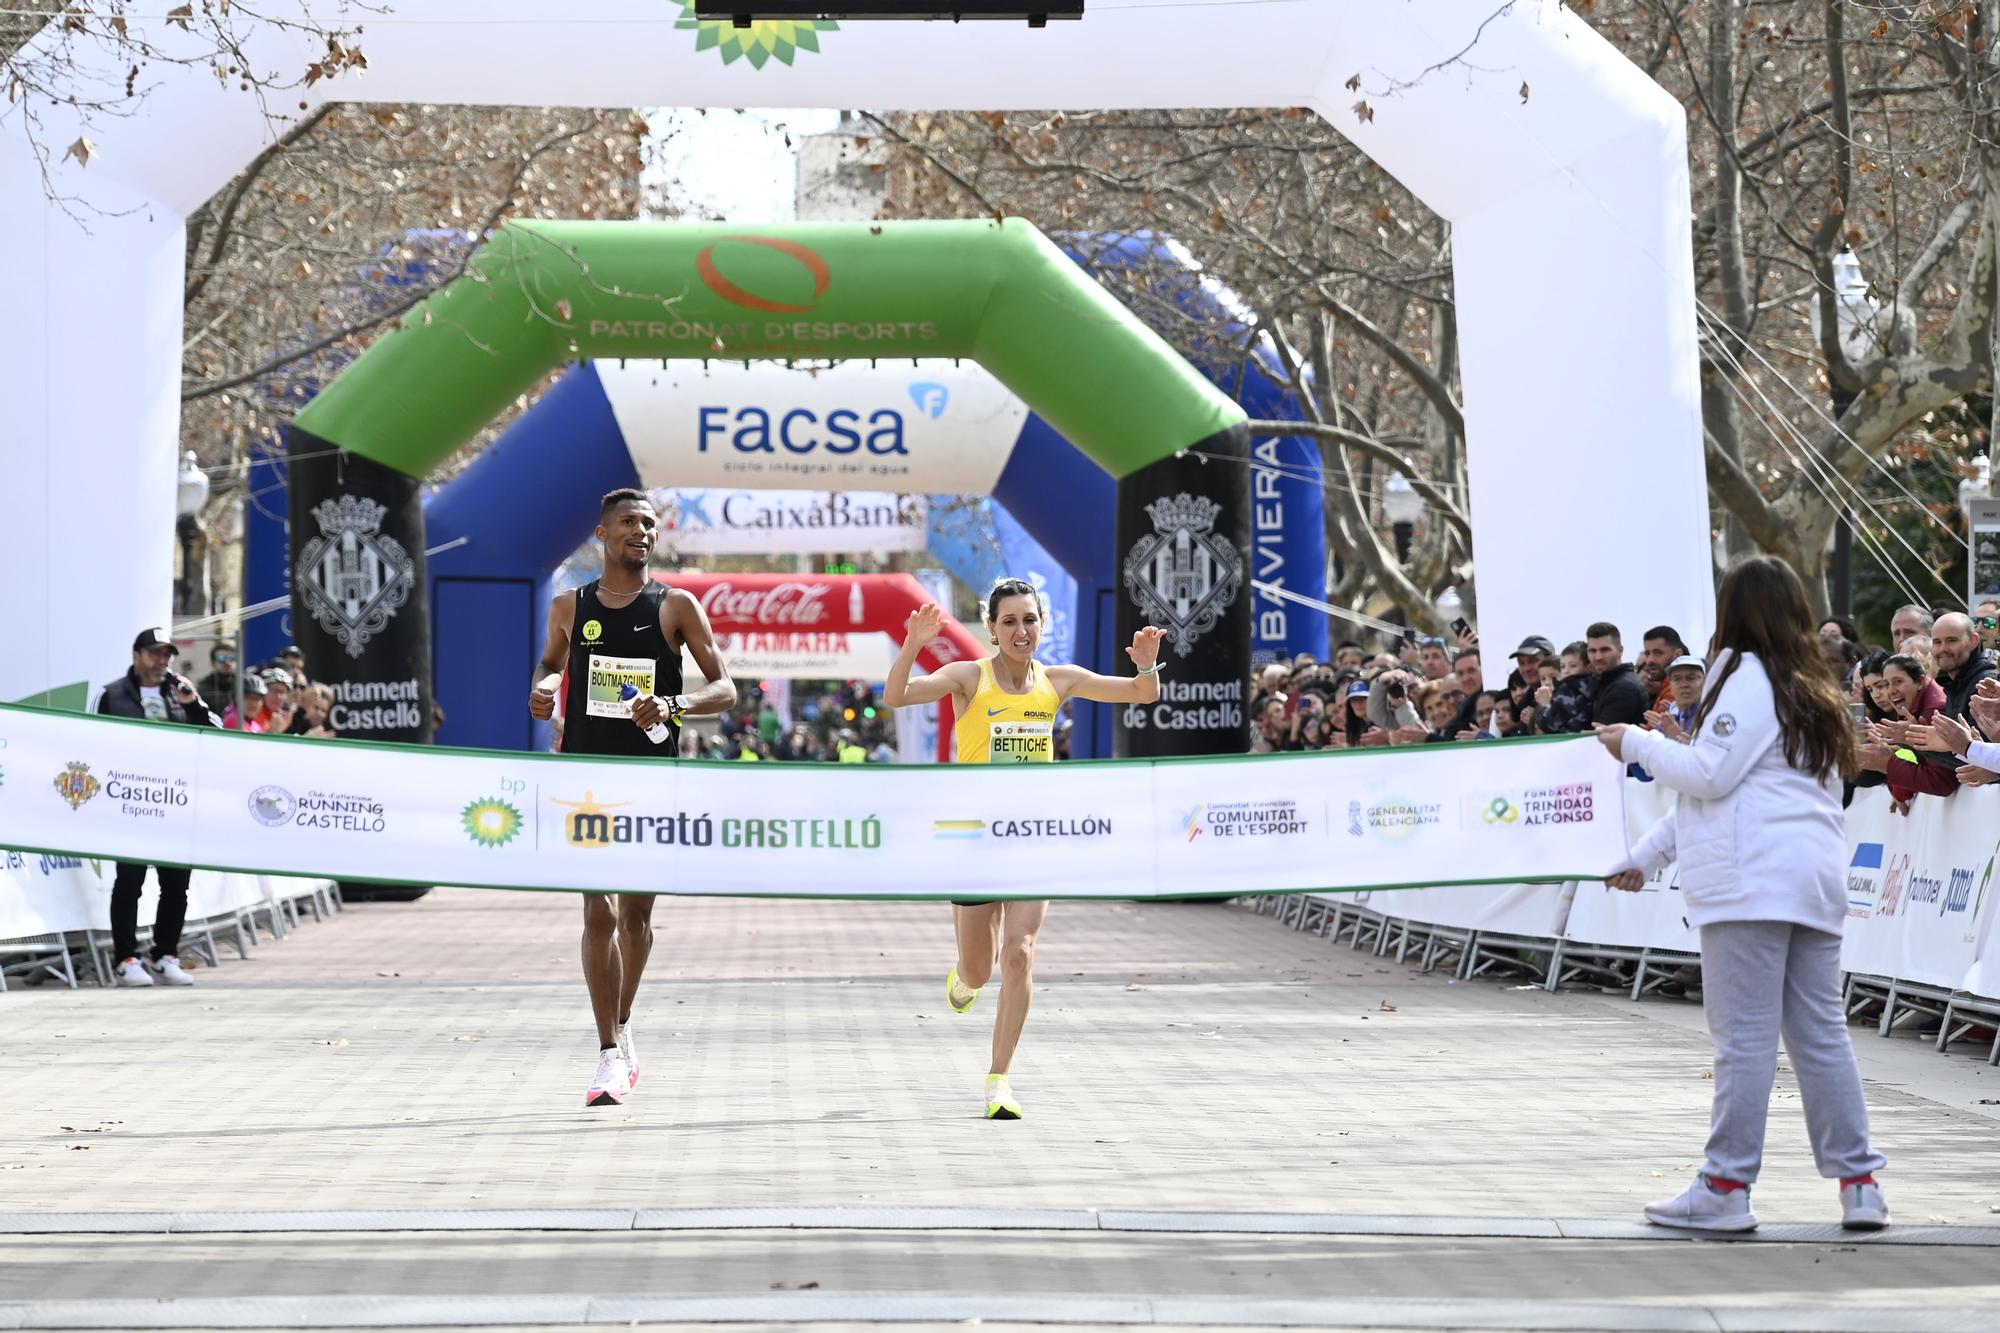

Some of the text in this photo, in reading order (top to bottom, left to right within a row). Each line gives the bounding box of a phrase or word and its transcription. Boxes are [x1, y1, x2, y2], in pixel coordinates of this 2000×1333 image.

[764, 320, 939, 341] D'ESPORTS
[769, 462, 834, 476] integral
[870, 465, 910, 476] agua
[722, 492, 914, 531] CaixaBank
[1254, 436, 1289, 642] BAVIERA
[333, 678, 419, 702] ntament
[1158, 679, 1242, 701] ntament
[329, 702, 421, 730] Castelló
[1123, 703, 1242, 730] de Castelló
[994, 738, 1048, 752] BETTICHE
[1015, 755, 1028, 763] 24
[106, 769, 187, 787] Ajuntament de
[501, 776, 526, 796] bp
[106, 780, 188, 807] Castelló
[1524, 785, 1593, 798] FUNDACIÓN
[121, 803, 166, 818] Esports
[298, 797, 384, 815] RUNNING
[1366, 804, 1440, 816] GENERALITAT
[1524, 797, 1593, 812] TRINIDAD
[296, 812, 385, 832] CASTELLÓ
[1207, 809, 1296, 823] COMUNITAT
[1368, 816, 1441, 827] VALENCIANA
[1524, 810, 1594, 826] ALFONSO
[572, 812, 882, 849] marató CASTELLÓ
[991, 815, 1112, 837] CASTELLÓN
[1214, 822, 1308, 836] DE L'ESPORT
